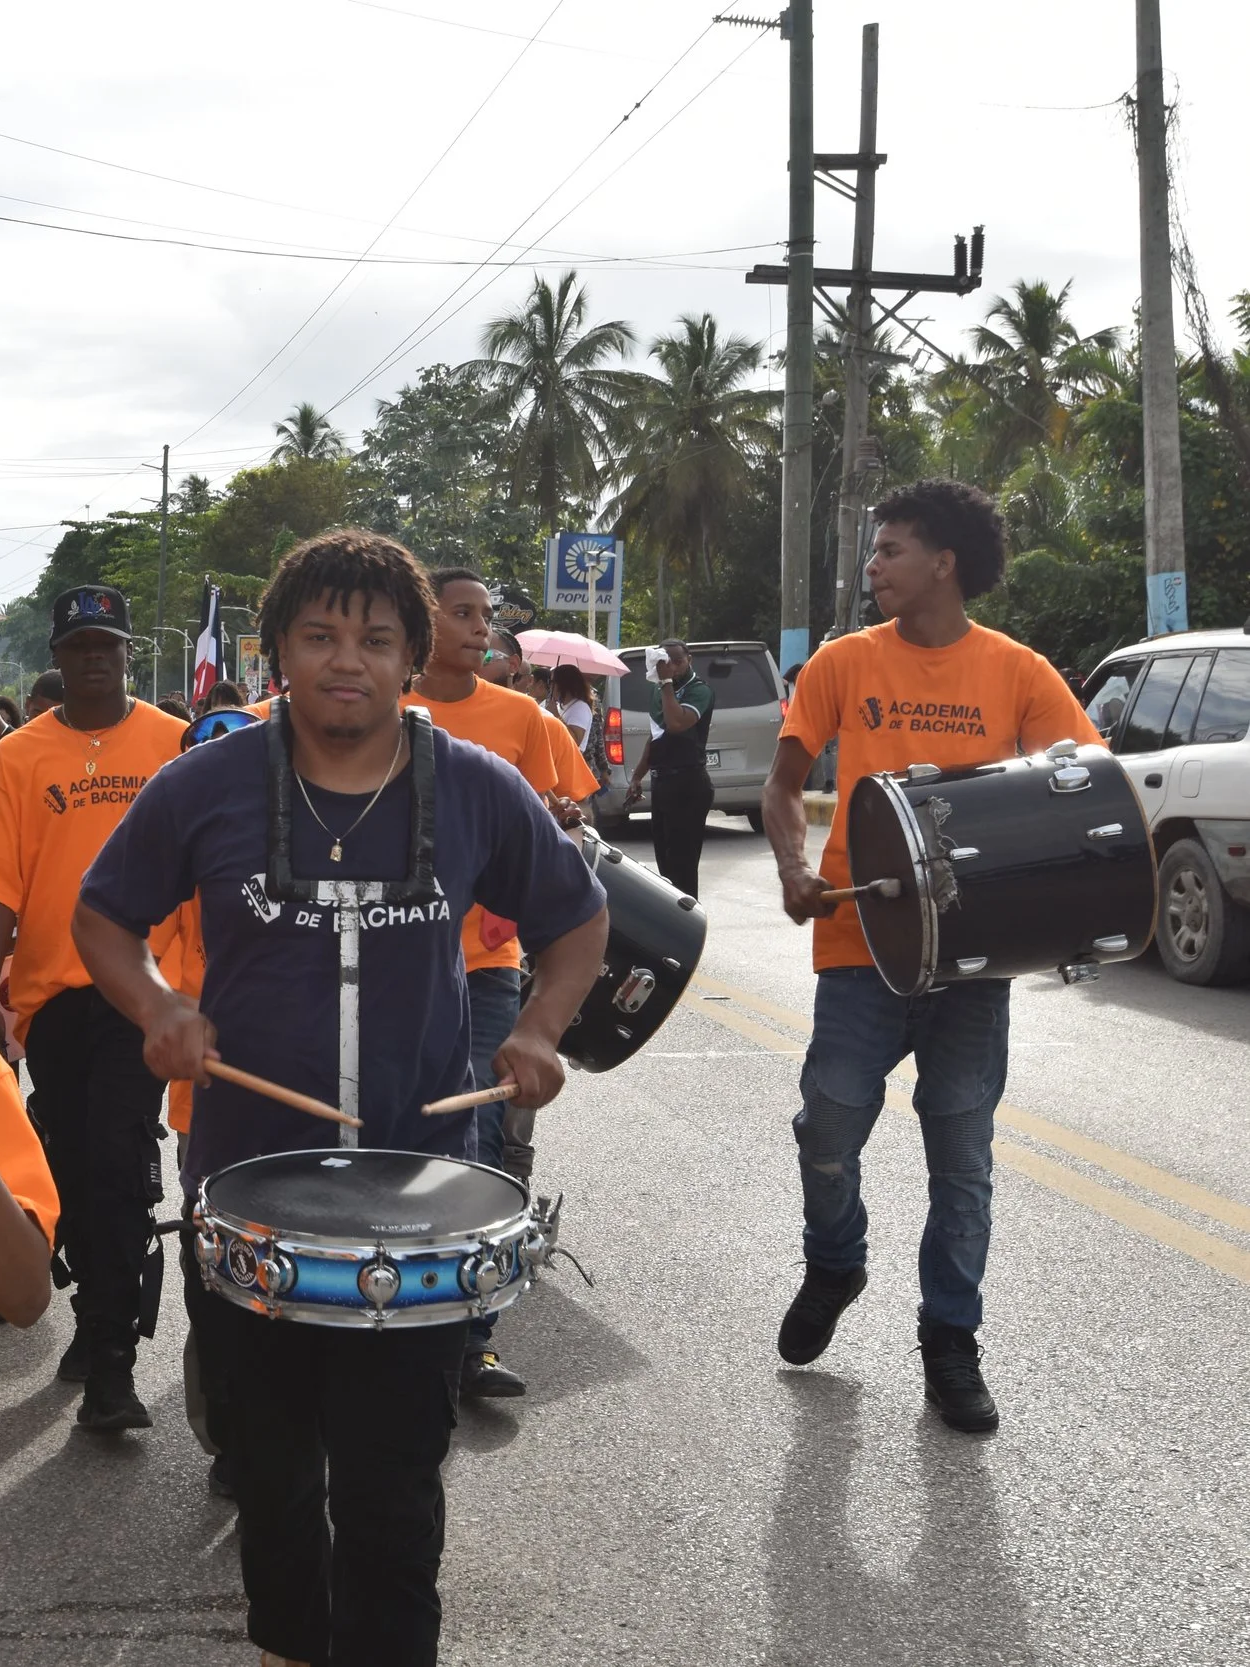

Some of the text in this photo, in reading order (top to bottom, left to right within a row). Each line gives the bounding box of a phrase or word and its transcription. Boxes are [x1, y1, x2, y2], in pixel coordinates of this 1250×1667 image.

[555, 592, 612, 605] POPUAR
[888, 700, 983, 721] ACADEMIA
[889, 718, 987, 738] DE BACHATA
[73, 791, 140, 809] DE BACHA
[295, 911, 322, 928] DE
